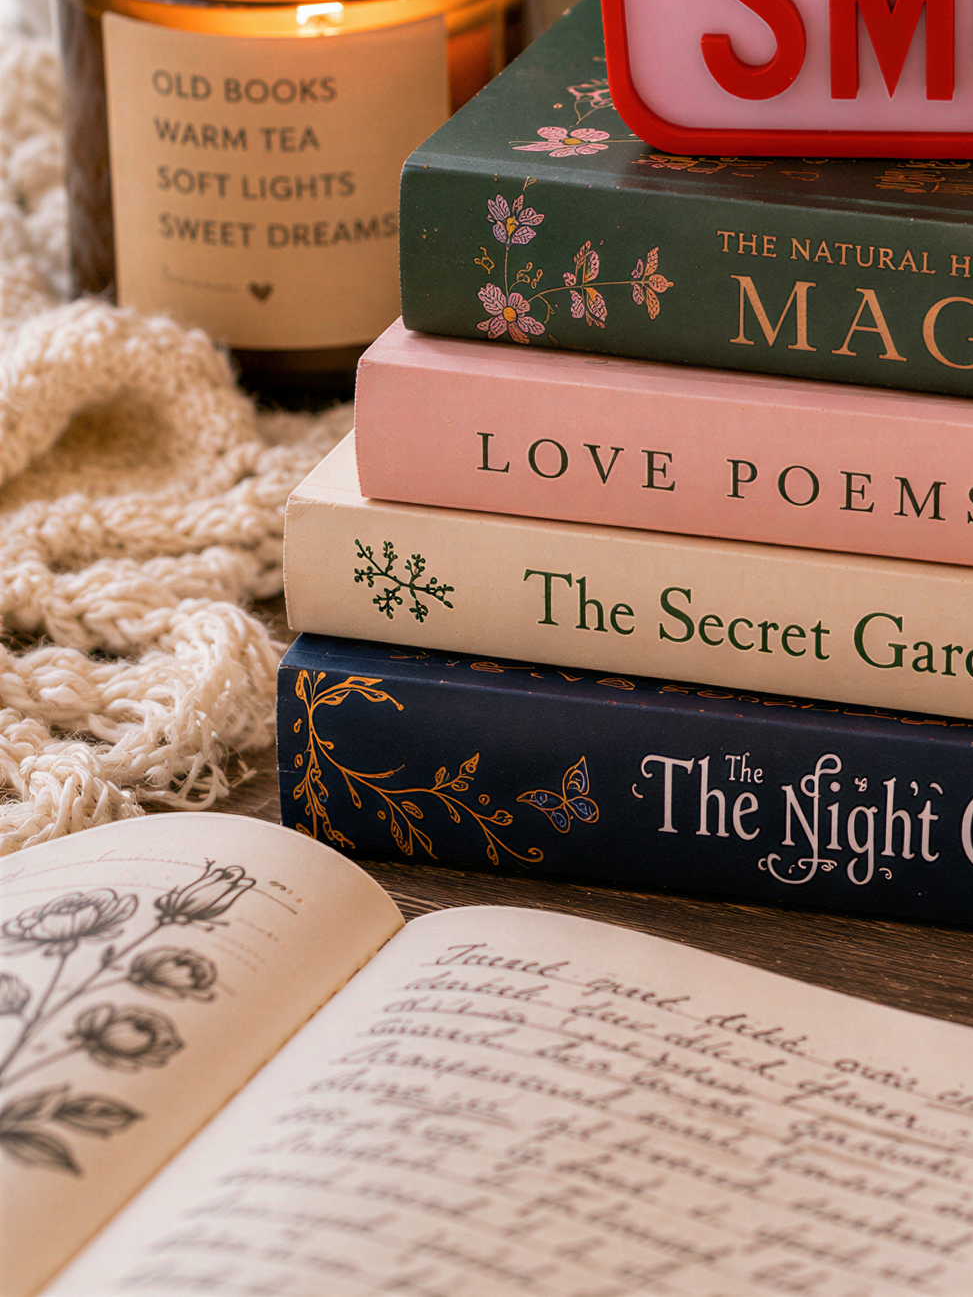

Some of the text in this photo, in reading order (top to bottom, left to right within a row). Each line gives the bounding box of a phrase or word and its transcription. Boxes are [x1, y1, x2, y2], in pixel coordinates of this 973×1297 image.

[153, 69, 337, 105] OLD BOOKS
[154, 117, 320, 153] WARM TEA
[157, 166, 355, 201] SOFT LIGHTS
[159, 211, 399, 249] SWEET DREAMS
[717, 230, 778, 259] THE
[790, 237, 936, 274] NATURAL
[477, 432, 677, 493] LOVE
[522, 568, 636, 638] The
[659, 586, 832, 663] Secret
[724, 751, 764, 785] The
[638, 753, 762, 841] The
[758, 752, 943, 886] Night
